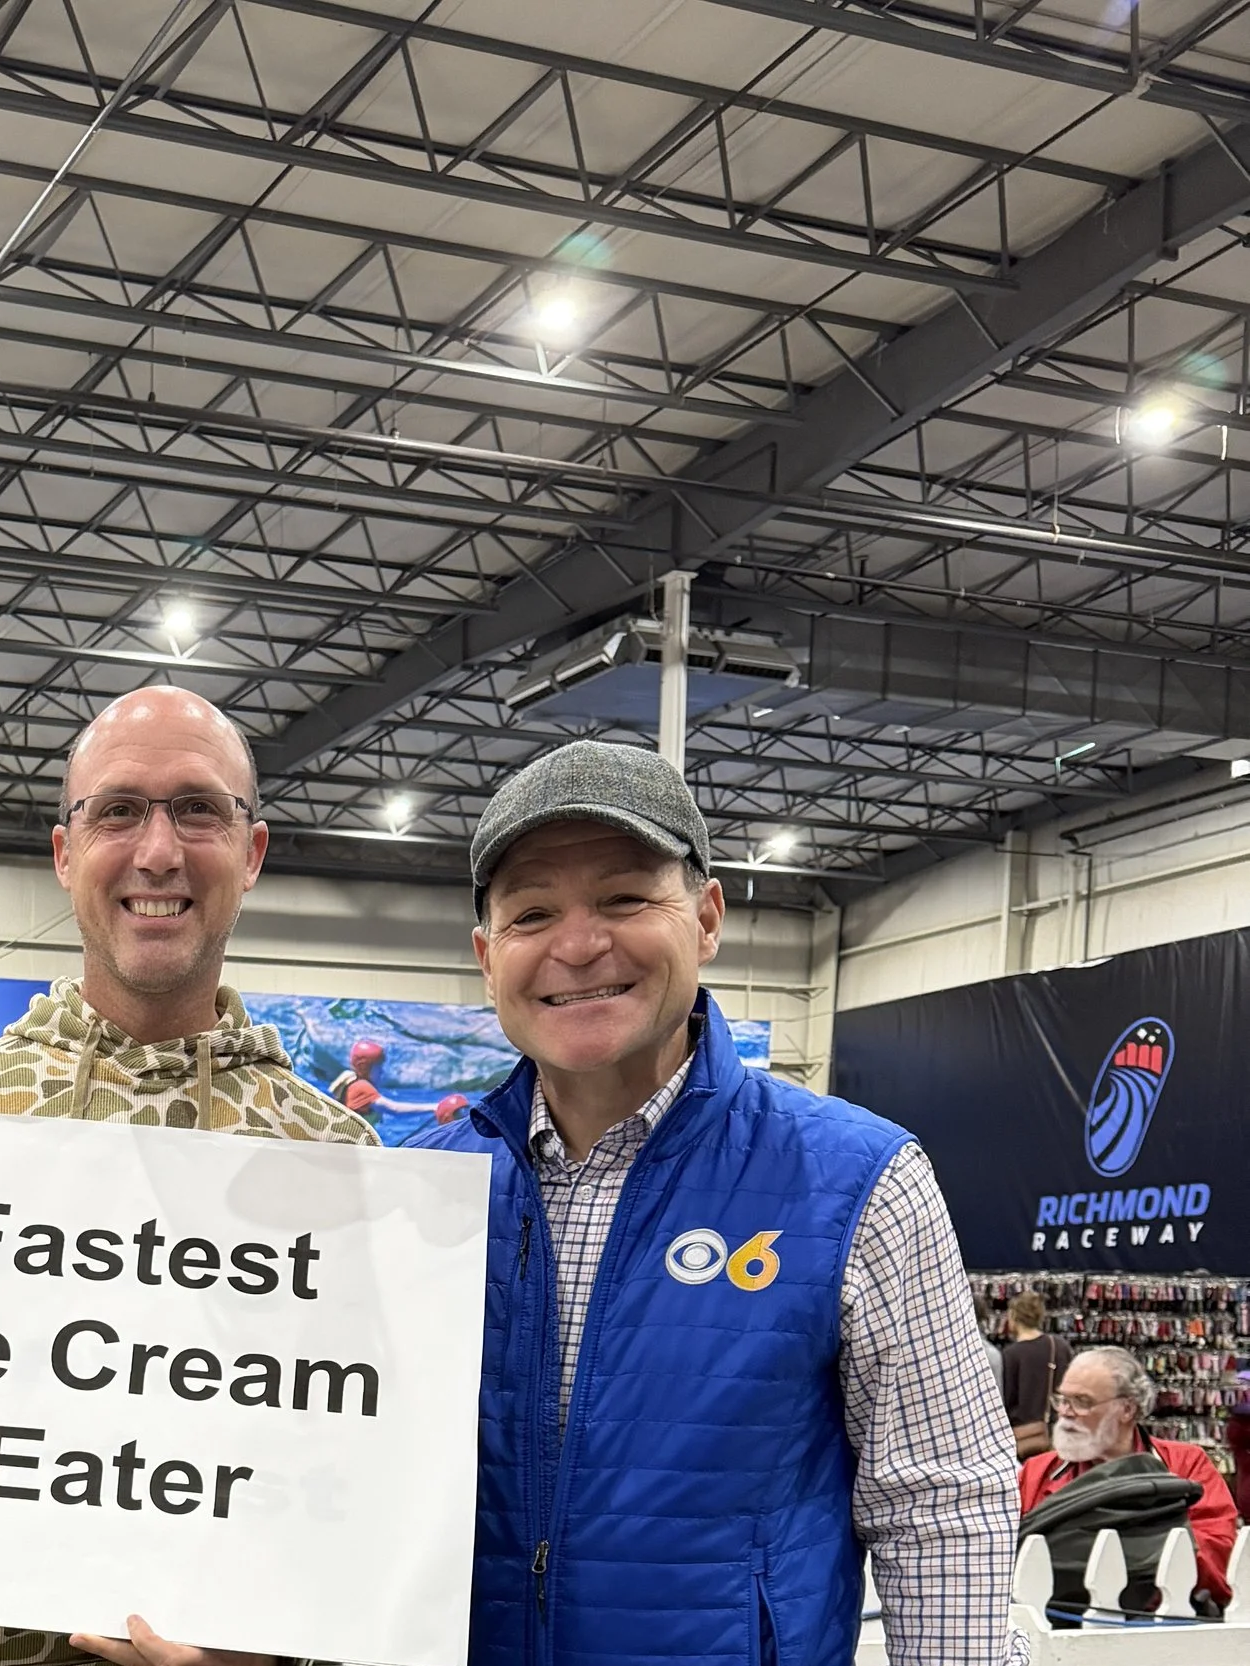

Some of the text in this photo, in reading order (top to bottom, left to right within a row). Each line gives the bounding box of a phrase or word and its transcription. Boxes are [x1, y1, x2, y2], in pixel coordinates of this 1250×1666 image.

[1036, 1183, 1212, 1228] RICHMOND
[1031, 1221, 1205, 1251] RACEWAY
[51, 1319, 379, 1417] Cream
